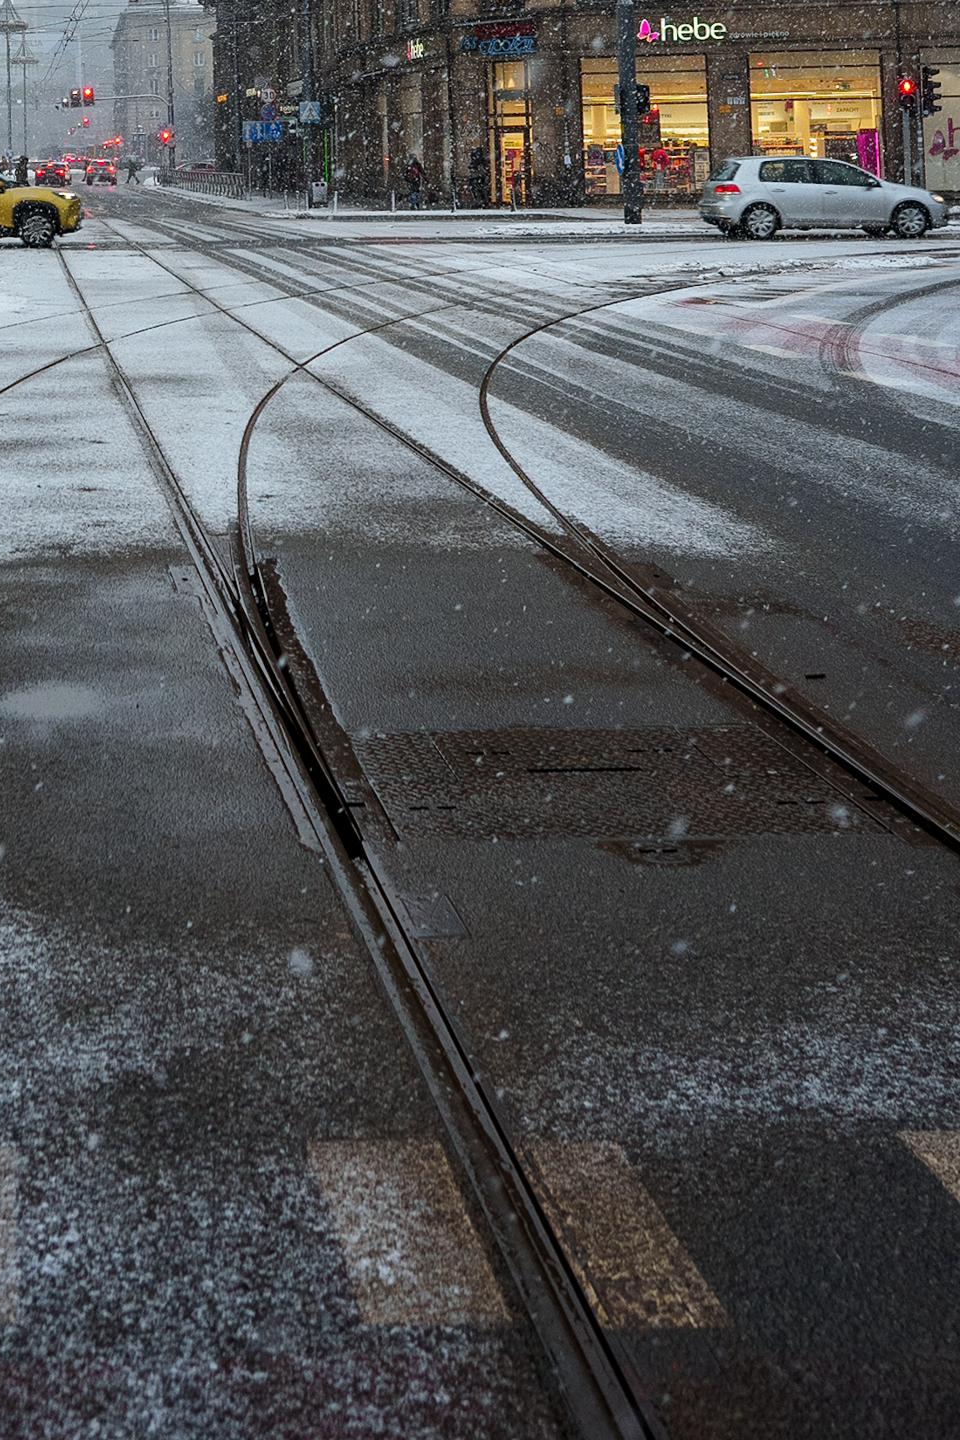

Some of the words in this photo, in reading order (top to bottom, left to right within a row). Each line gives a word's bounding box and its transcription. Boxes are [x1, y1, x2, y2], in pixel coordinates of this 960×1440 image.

[660, 16, 727, 42] hebe
[410, 38, 424, 60] hebe
[263, 91, 274, 100] 30
